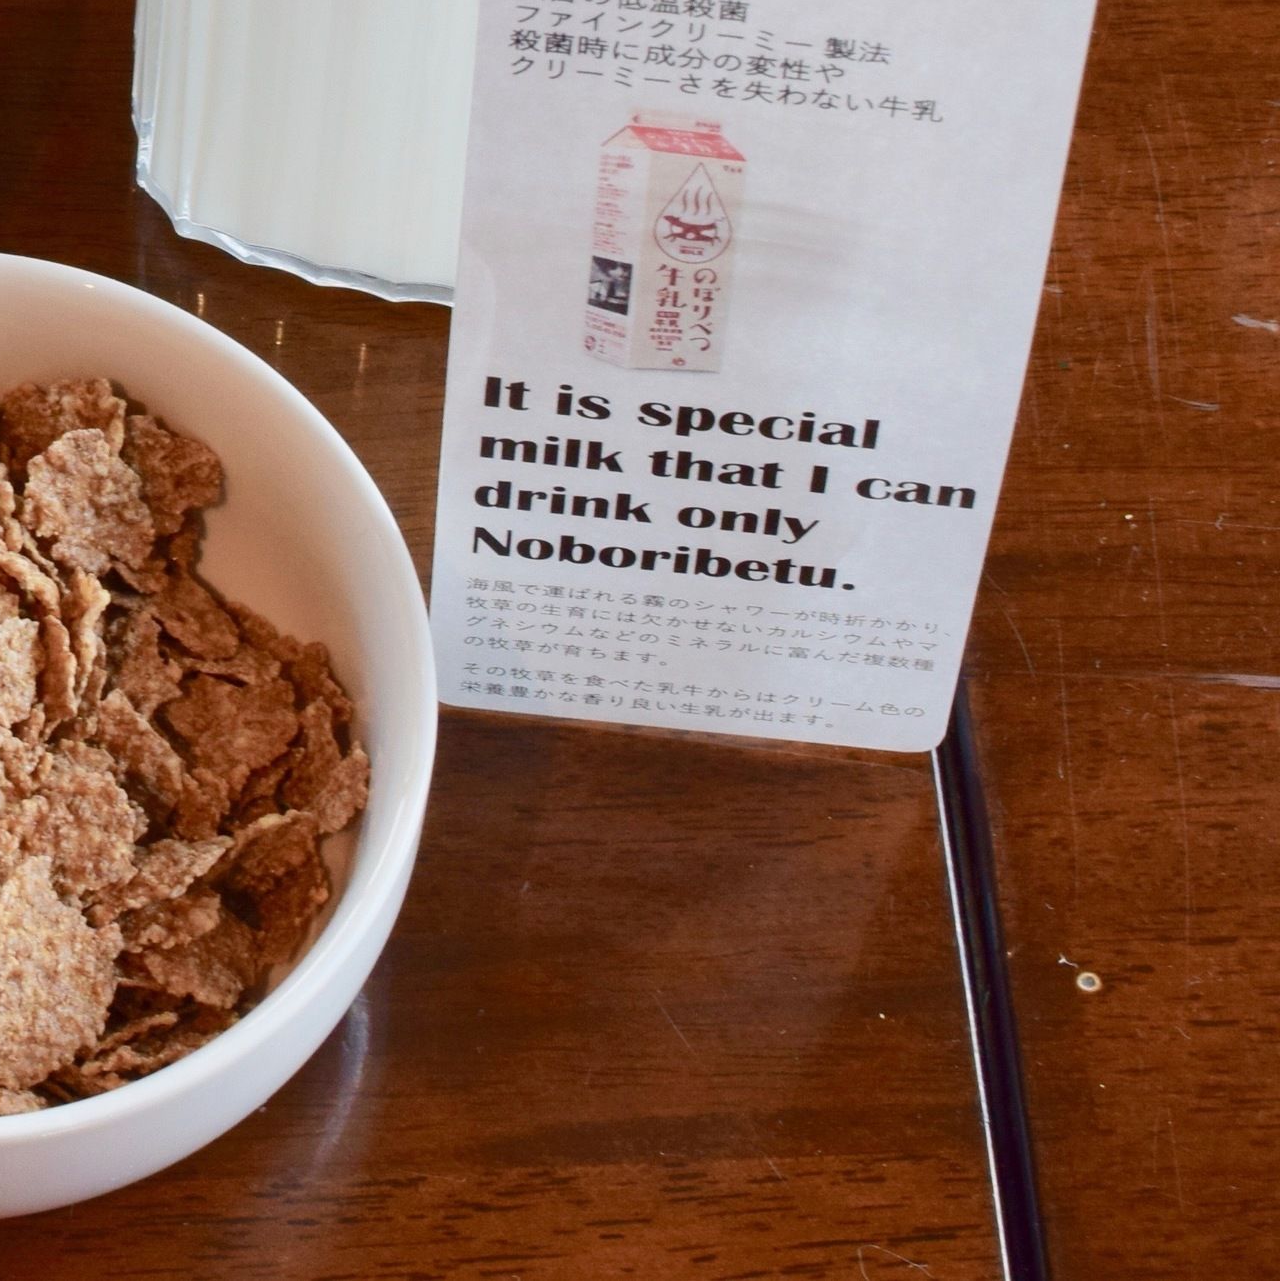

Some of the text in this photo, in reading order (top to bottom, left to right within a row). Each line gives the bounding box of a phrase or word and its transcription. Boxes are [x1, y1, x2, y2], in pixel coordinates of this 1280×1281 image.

[510, 29, 845, 83] 殺菌時に成分の変性や
[511, 56, 944, 123] クリーミーさを失わない牛乳
[483, 377, 880, 450] It is special
[479, 434, 977, 509] milk that I can
[474, 481, 820, 545] drink only
[472, 527, 855, 591] Noboribetu.
